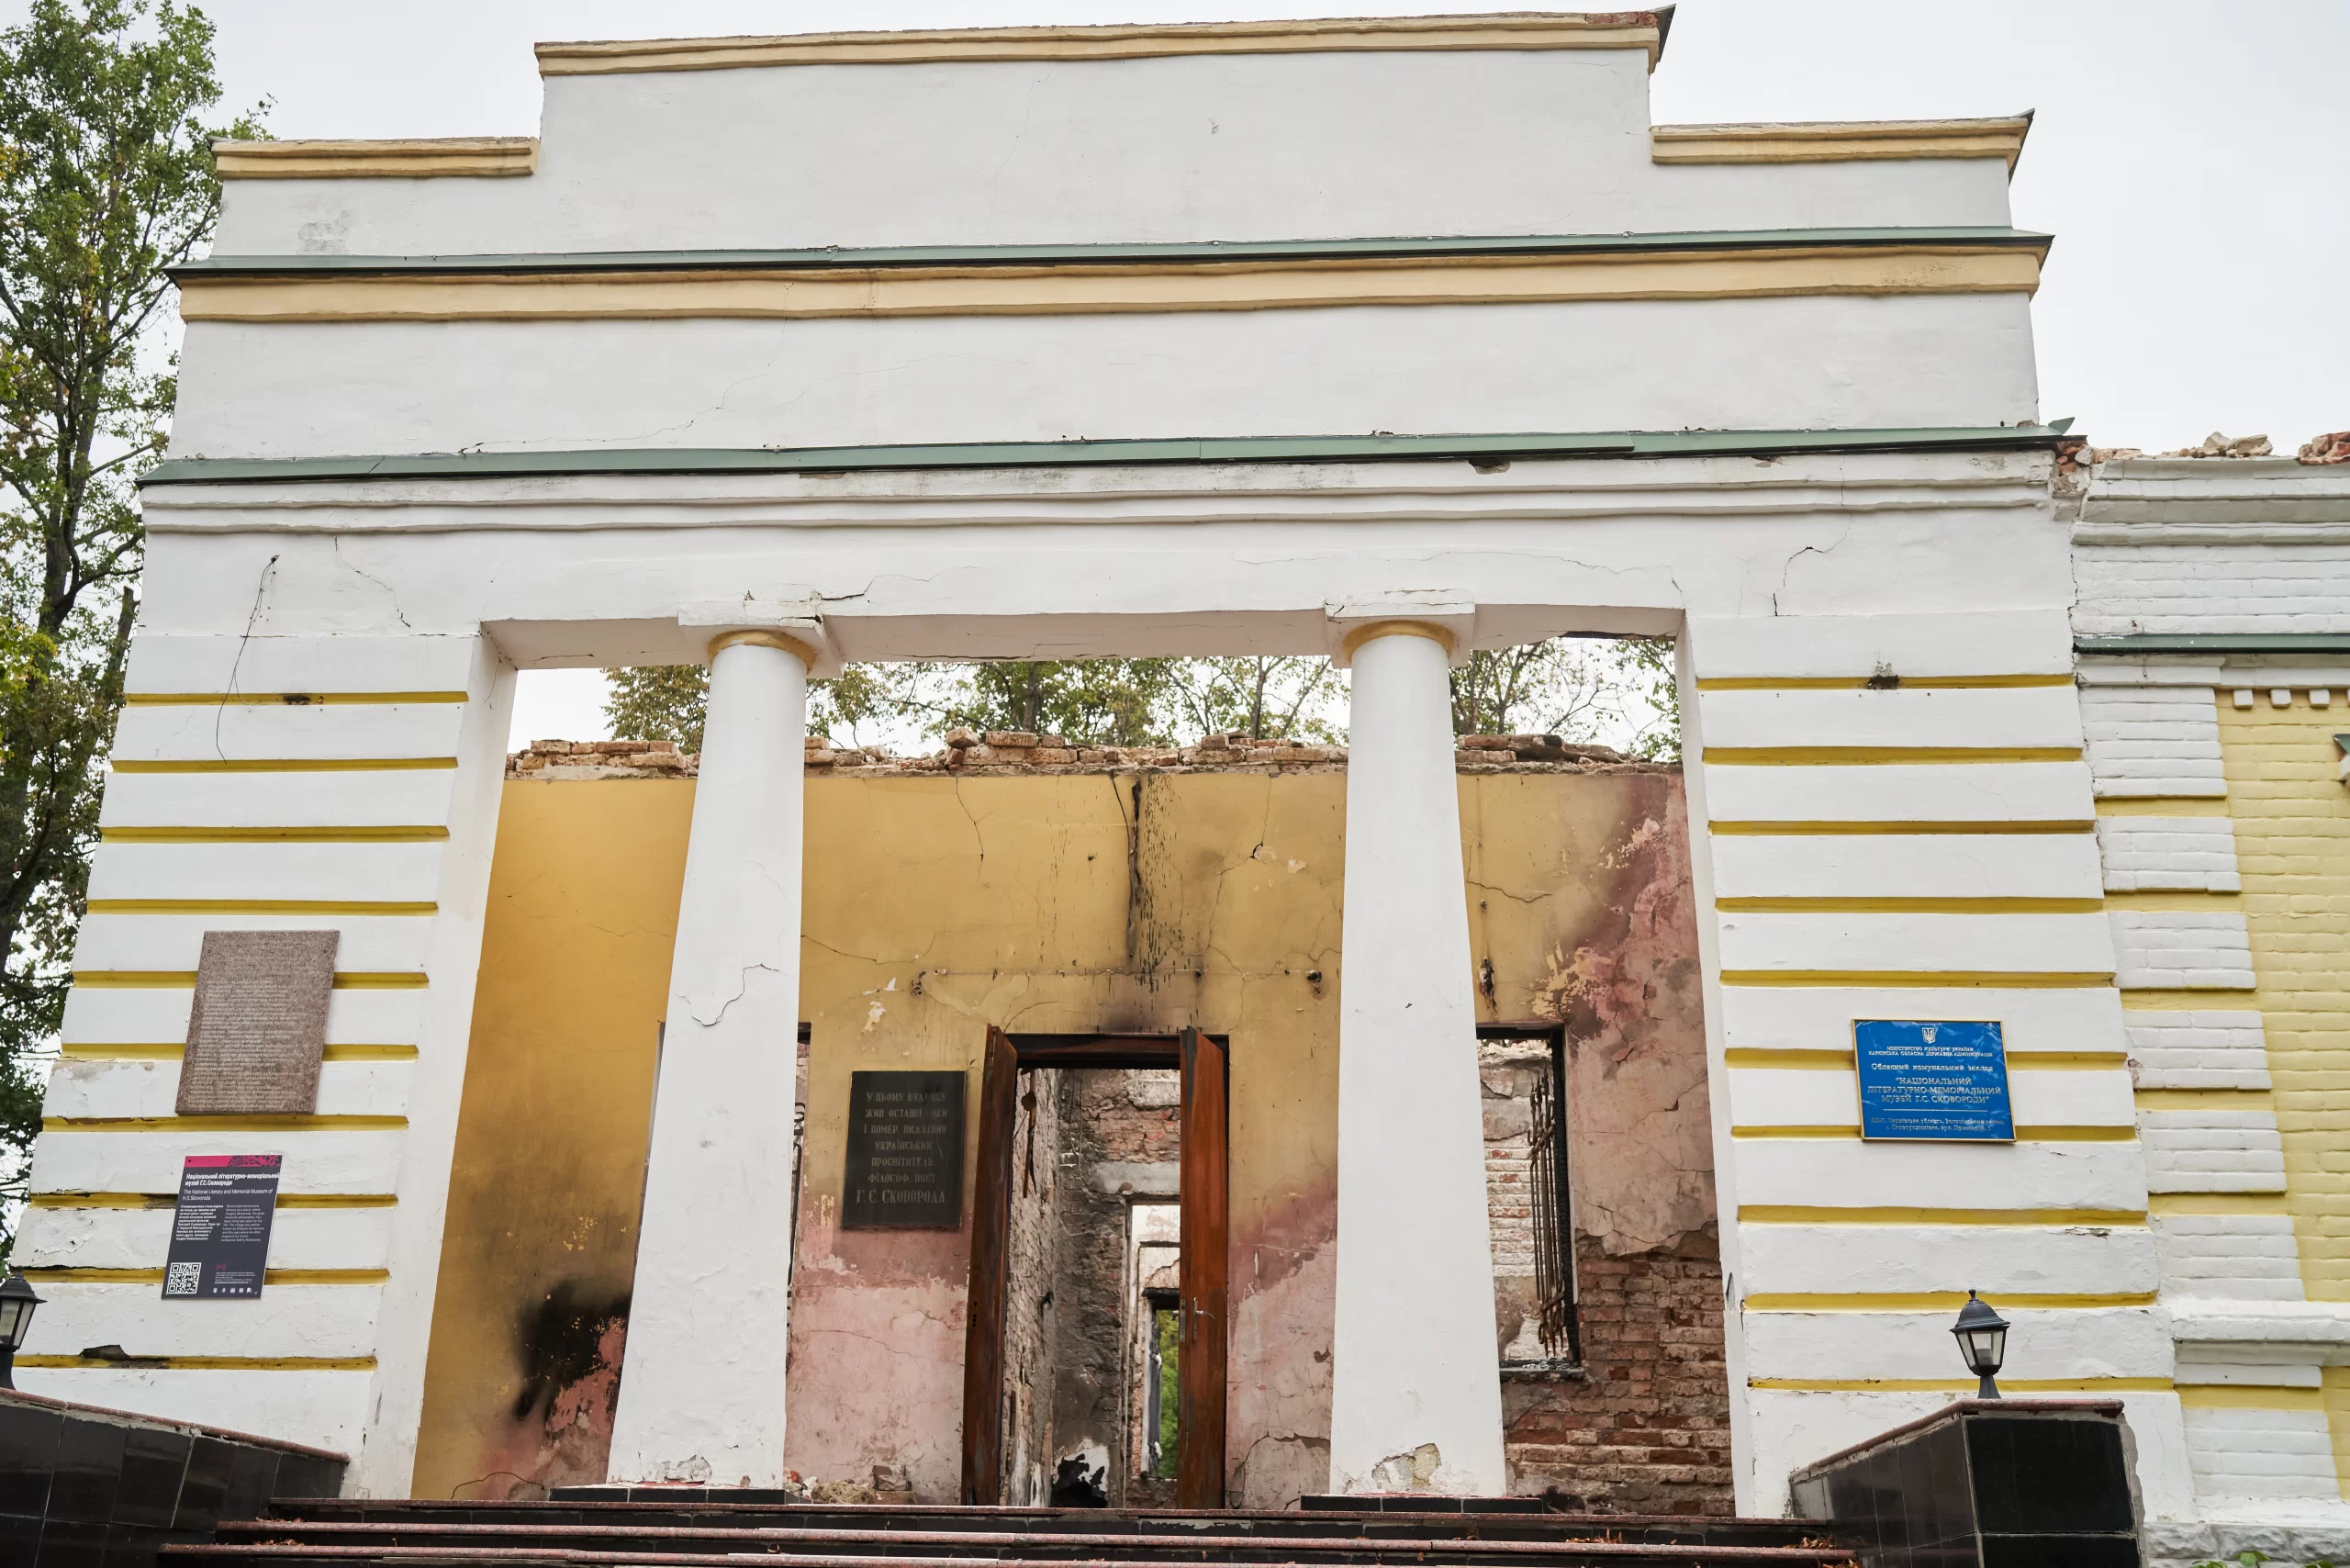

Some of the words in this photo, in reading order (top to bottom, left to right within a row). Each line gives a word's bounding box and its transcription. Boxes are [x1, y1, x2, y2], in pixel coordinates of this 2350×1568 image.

[1912, 1064, 1964, 1072] комунальний
[1867, 1086, 2002, 1094] ЛІТЕРАТУРНО-МЕМОРІАЛЬНИЙ
[866, 1092, 874, 1102] У
[875, 1092, 904, 1103] ЦЬОМУ
[1881, 1094, 1912, 1103] МУЗЕЙ
[865, 1108, 885, 1118] ЖИВ
[888, 1105, 923, 1118] ОСТАННІ
[926, 1108, 948, 1117] ОКИ
[870, 1125, 899, 1134] ПОМЕР
[874, 1138, 933, 1150] УКРАЇНСЬКИЙ
[914, 1172, 937, 1182] ПОЕТ
